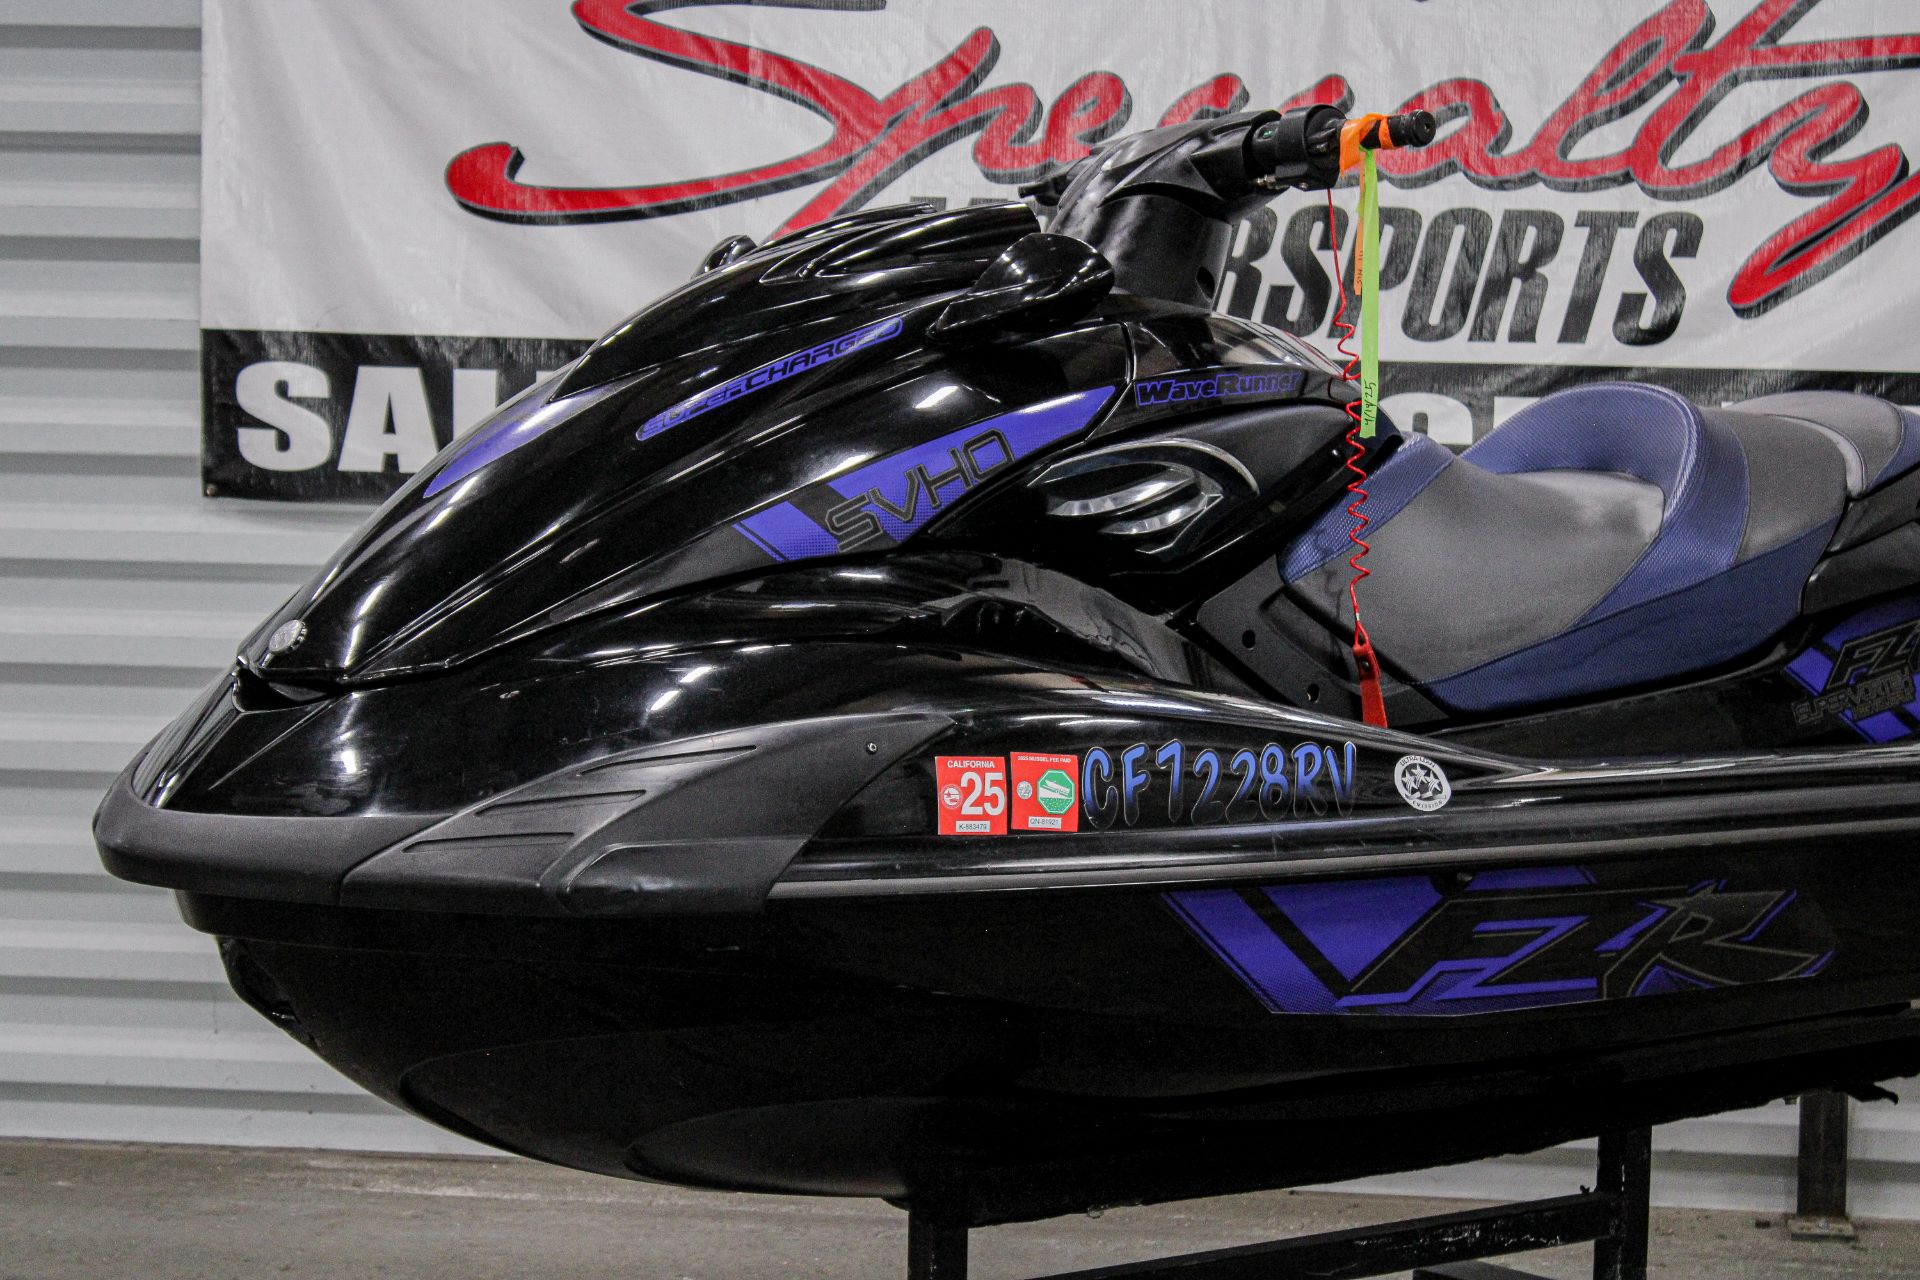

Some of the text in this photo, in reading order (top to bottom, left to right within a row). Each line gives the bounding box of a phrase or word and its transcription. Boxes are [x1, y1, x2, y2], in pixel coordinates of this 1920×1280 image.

[1137, 373, 1300, 406] WaveRunner
[826, 429, 1016, 552] SVHO
[1838, 619, 1920, 691] FZ
[947, 760, 995, 769] CALIFORNIA
[960, 771, 1005, 816] 25
[1335, 879, 1835, 1007] FZR
